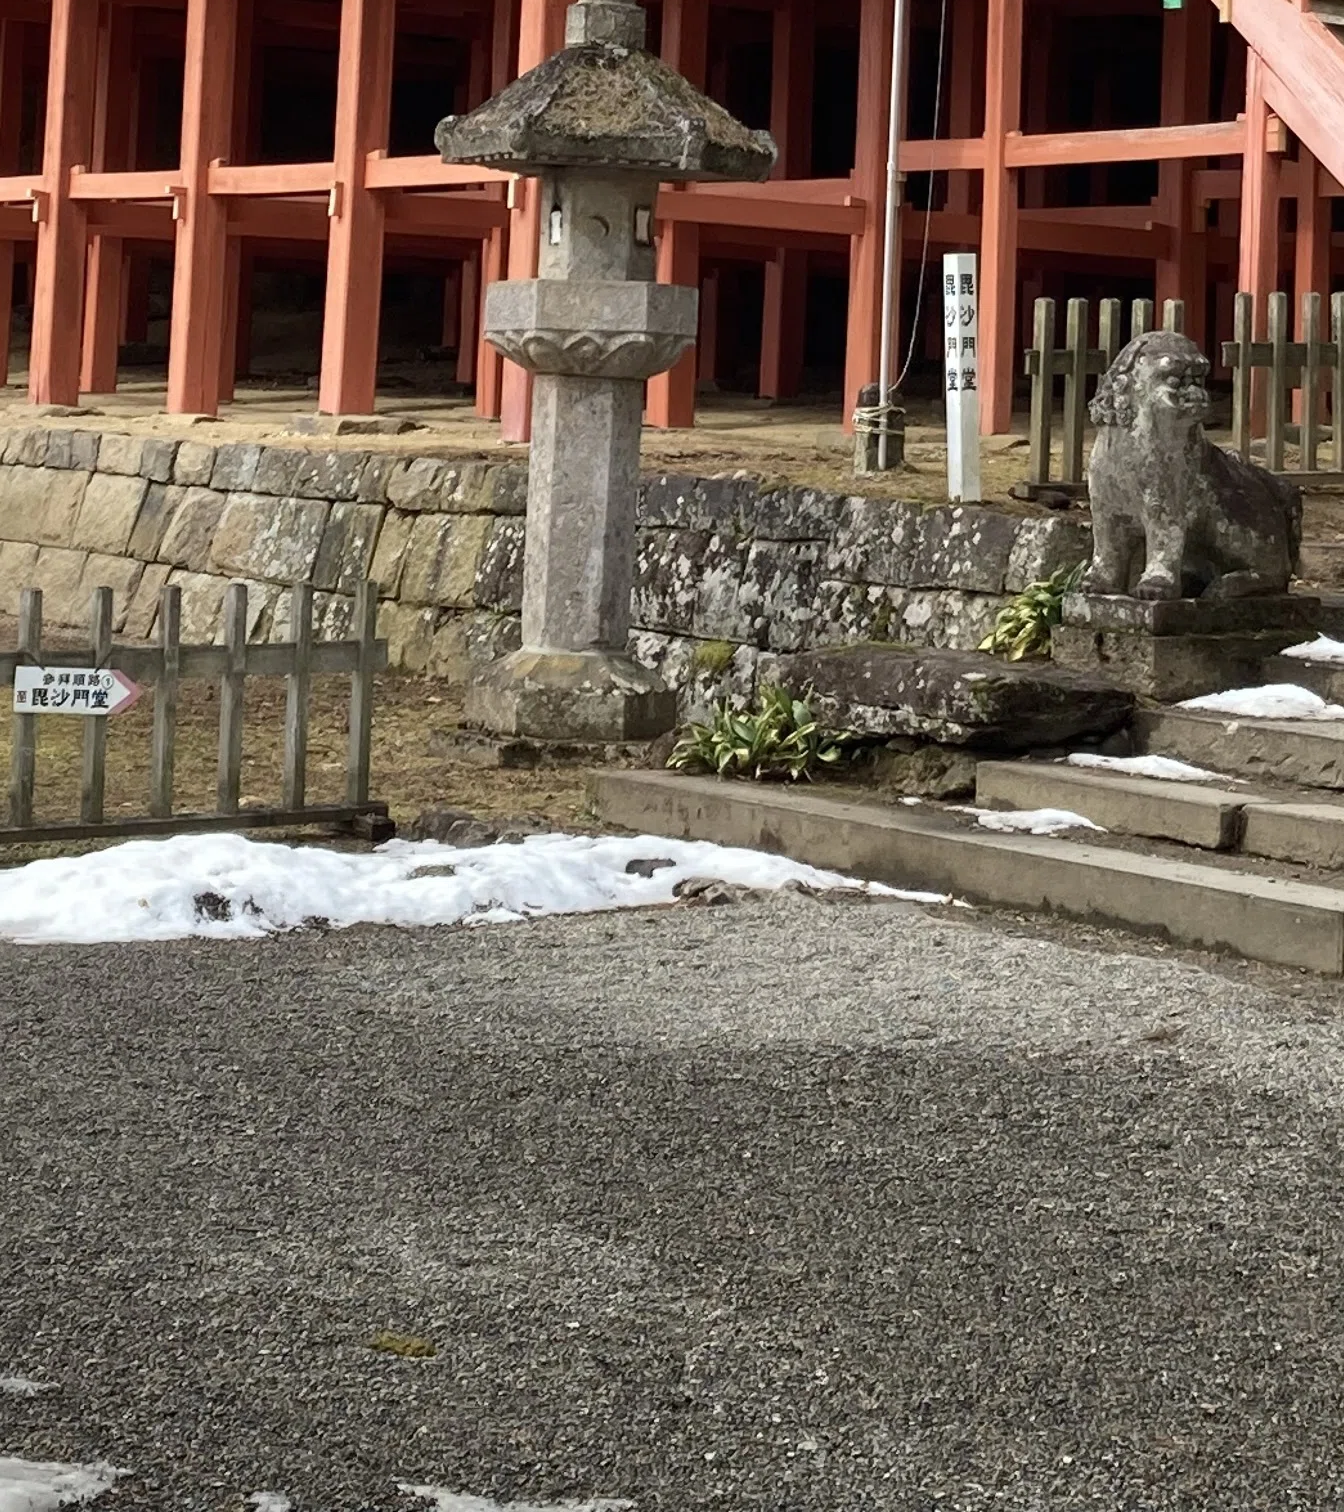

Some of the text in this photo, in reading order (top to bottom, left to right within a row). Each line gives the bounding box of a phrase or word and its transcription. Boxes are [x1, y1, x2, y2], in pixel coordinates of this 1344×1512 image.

[960, 274, 977, 391] 毘沙門堂
[32, 688, 109, 708] 毘沙門堂
